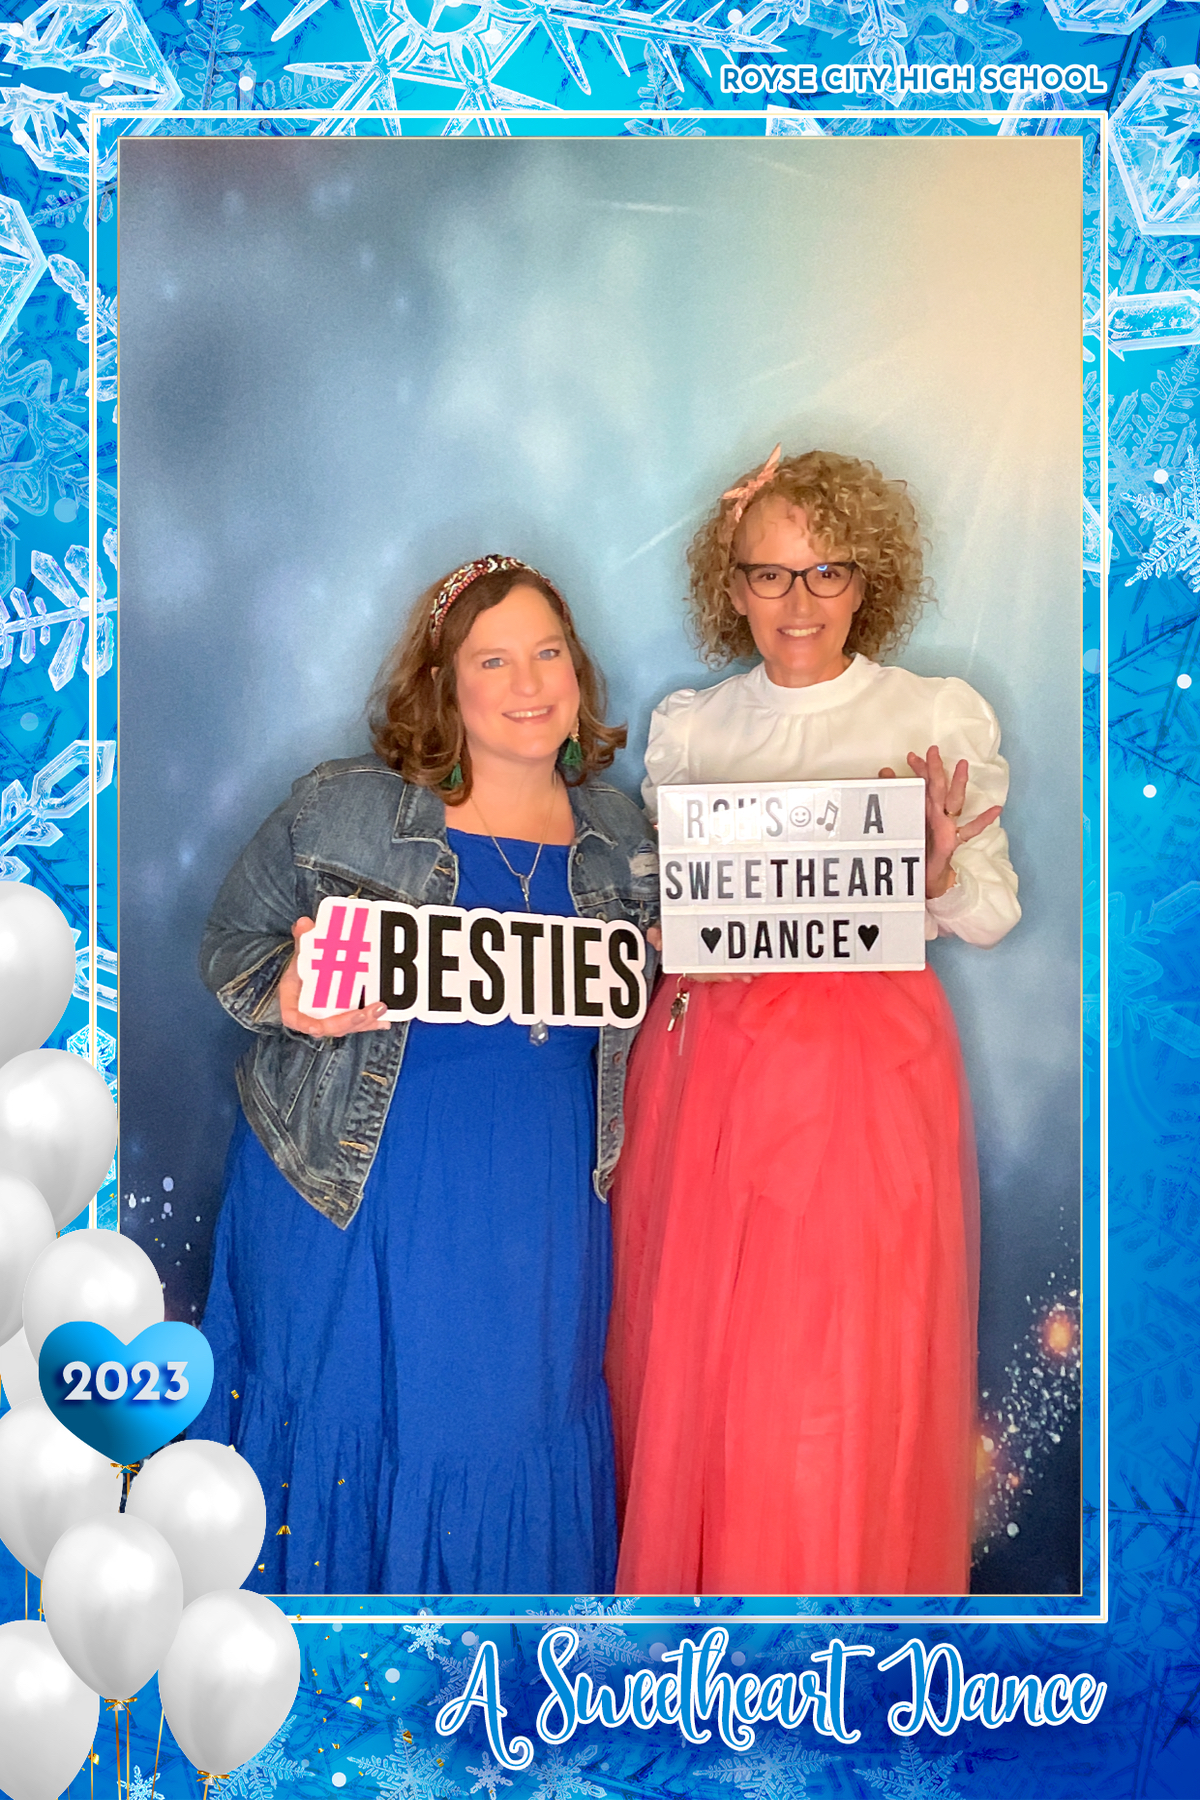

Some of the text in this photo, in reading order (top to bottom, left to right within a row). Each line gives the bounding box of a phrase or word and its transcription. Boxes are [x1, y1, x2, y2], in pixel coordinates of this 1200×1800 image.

[687, 793, 884, 838] RS A
[665, 857, 920, 900] SWEETHEART
[727, 920, 850, 959] DANCE
[311, 905, 640, 1020] #BESTIES
